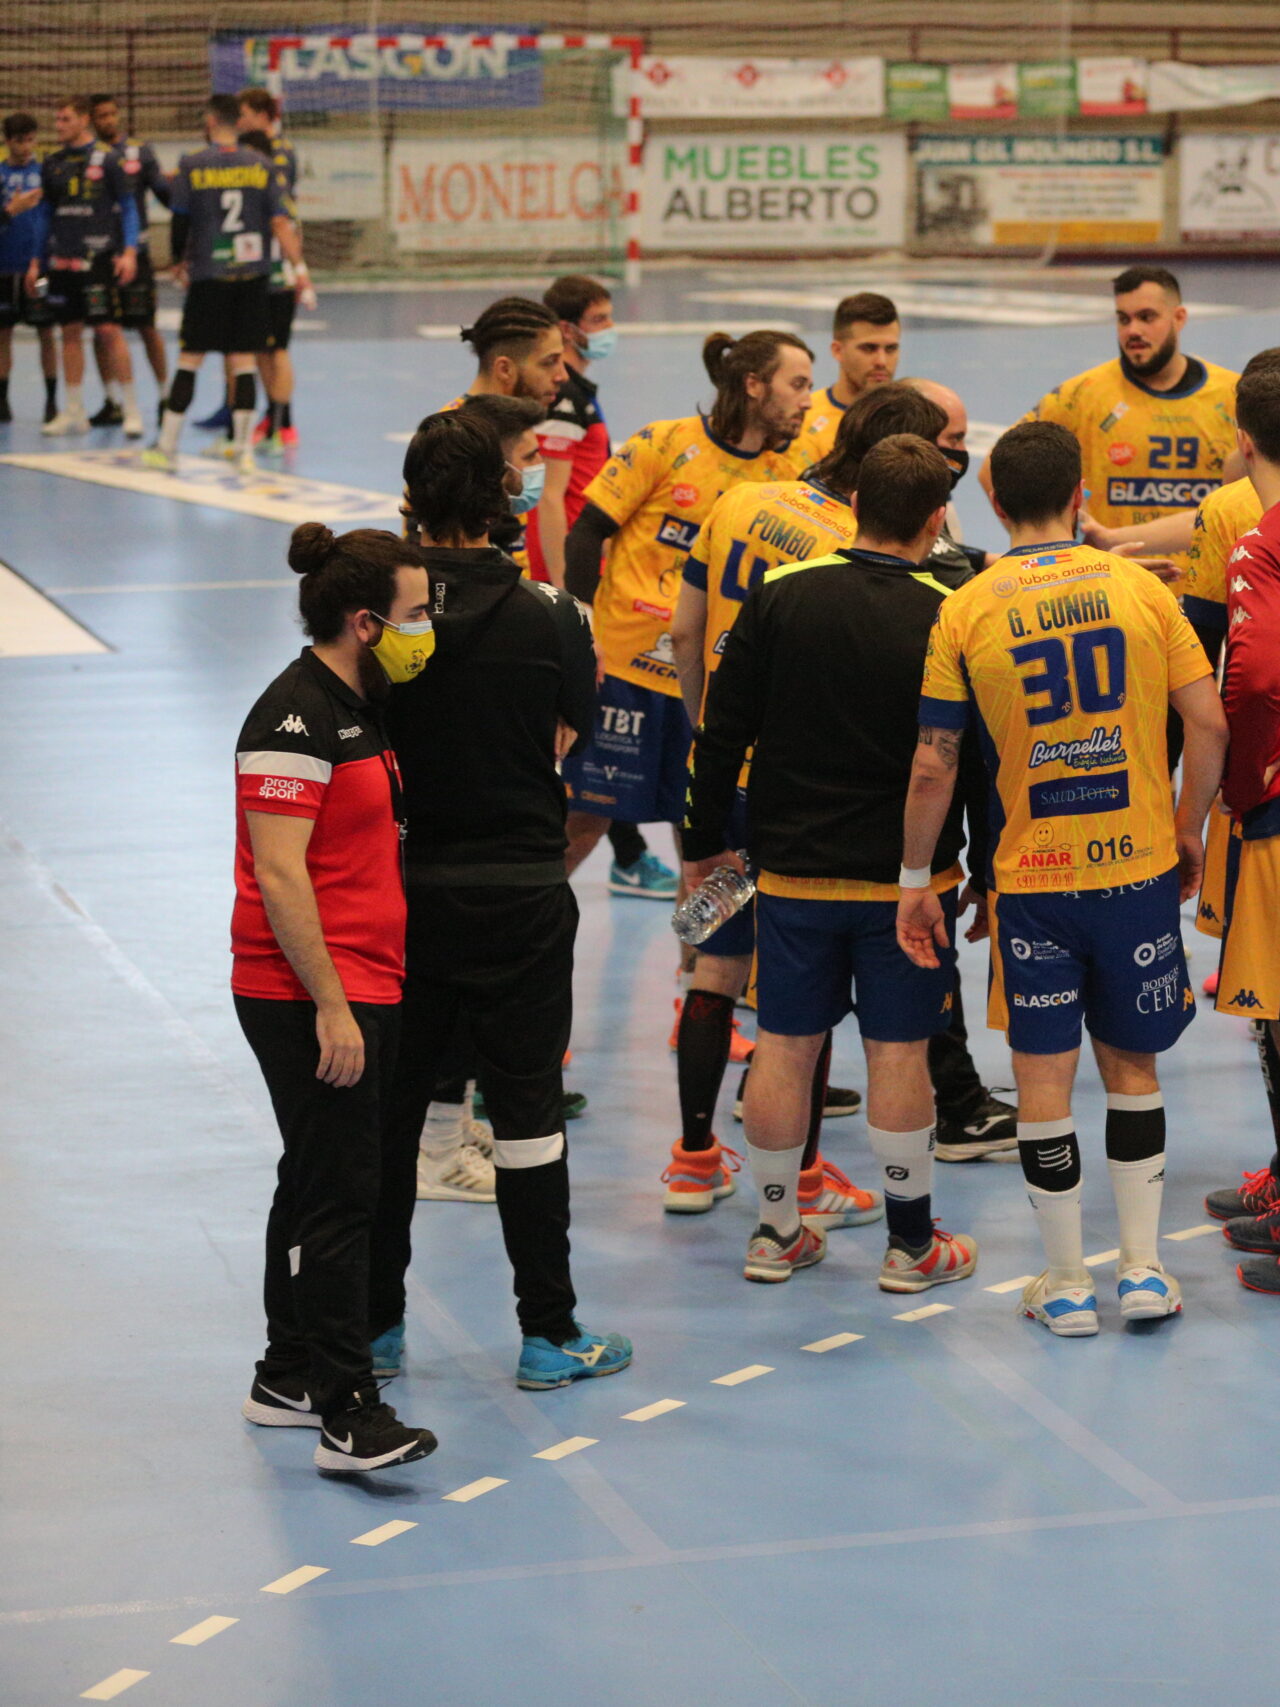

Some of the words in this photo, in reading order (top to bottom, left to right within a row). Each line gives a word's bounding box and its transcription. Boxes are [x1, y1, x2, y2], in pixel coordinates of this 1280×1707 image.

[662, 143, 881, 182] MUEBLES
[221, 189, 244, 233] 2
[662, 185, 880, 222] ALBERTO
[1148, 435, 1199, 470] 29
[748, 509, 818, 562] POMBO
[1018, 573, 1058, 586] tubos
[1062, 561, 1111, 578] aranda
[1007, 607, 1032, 638] G.
[1036, 589, 1111, 632] CUNHA
[1005, 626, 1127, 727] 30
[600, 705, 646, 737] TBT
[1029, 726, 1121, 766] Burpellet
[258, 784, 298, 800] sport
[264, 777, 305, 793] prado
[1018, 851, 1073, 868] ANAR
[1086, 834, 1134, 863] 016
[1014, 988, 1079, 1008] BLASGON
